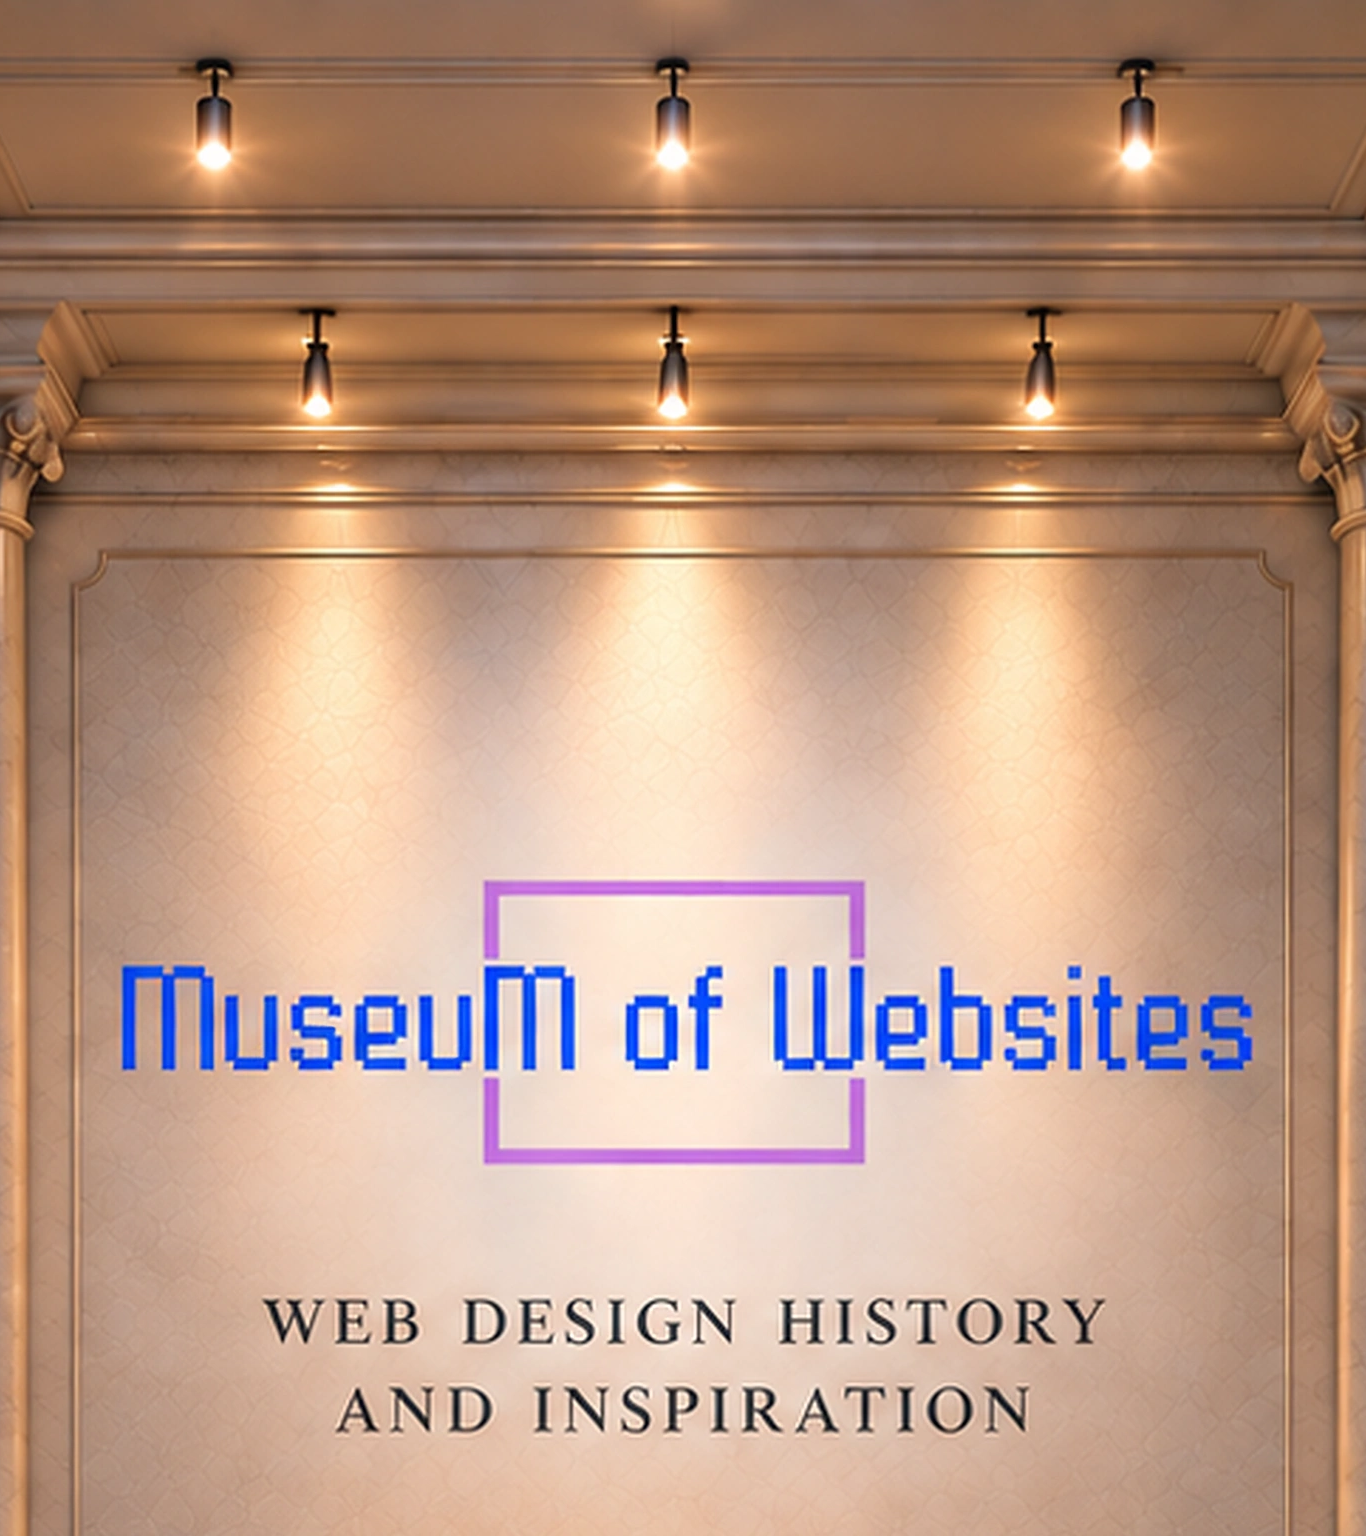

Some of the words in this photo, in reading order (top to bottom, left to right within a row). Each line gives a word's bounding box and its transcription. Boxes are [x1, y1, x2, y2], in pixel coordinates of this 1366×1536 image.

[624, 965, 724, 1071] of
[773, 965, 1253, 1071] Websites
[263, 1299, 419, 1344] WEB
[464, 1298, 734, 1345] DESIGN
[780, 1298, 1105, 1345] HISTORY
[336, 1387, 492, 1433] AND
[535, 1386, 1029, 1434] INSPIRATION
